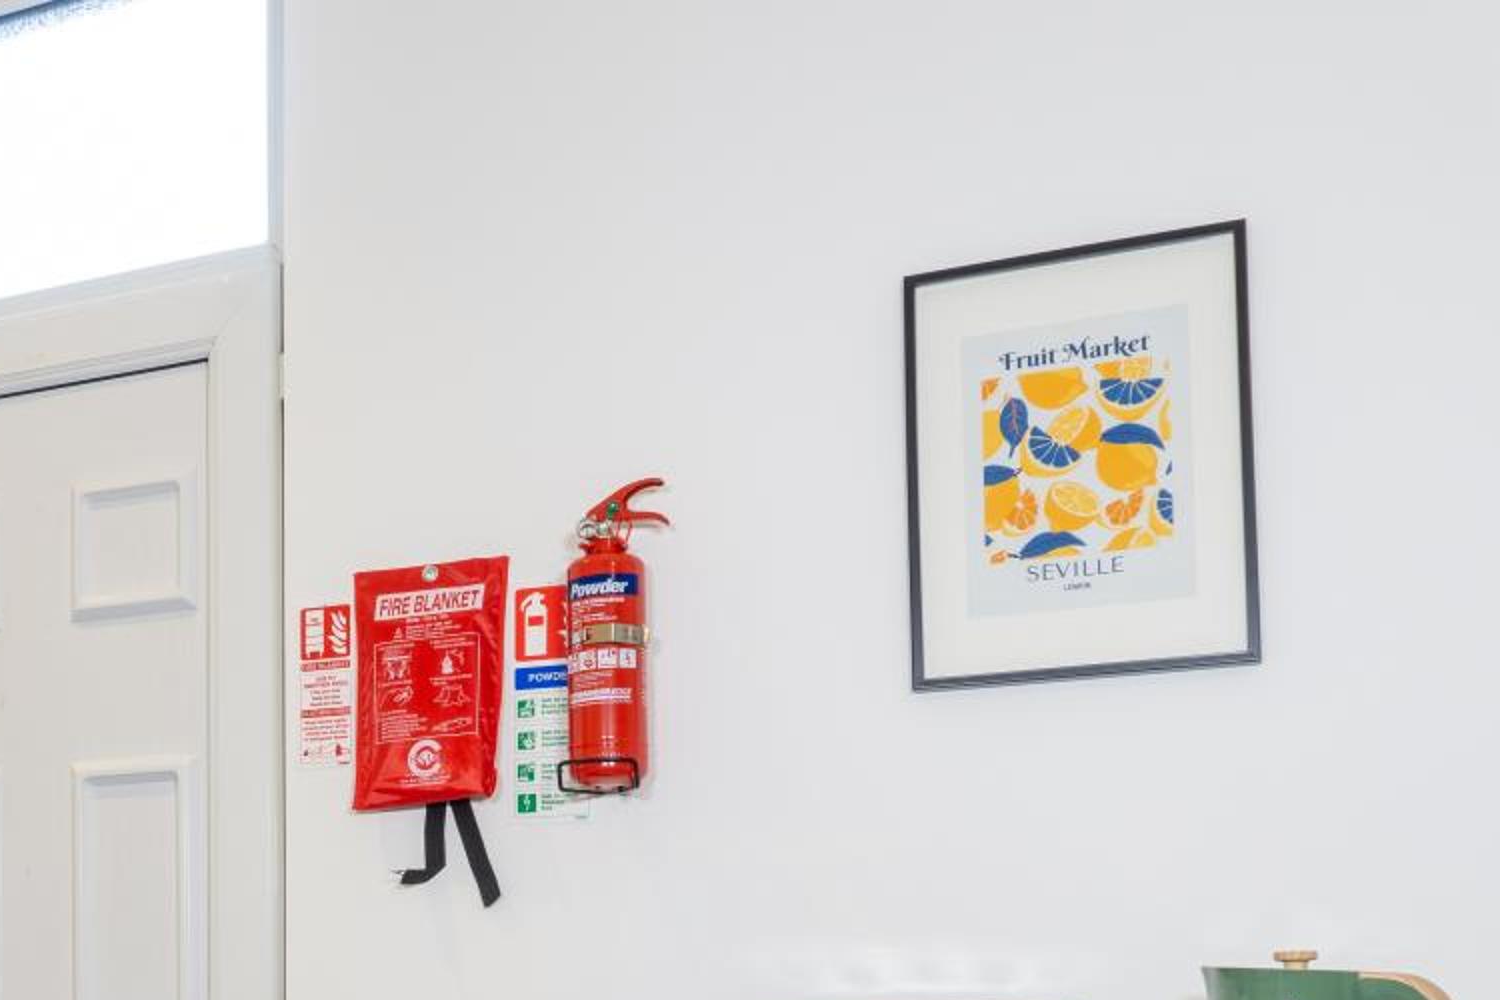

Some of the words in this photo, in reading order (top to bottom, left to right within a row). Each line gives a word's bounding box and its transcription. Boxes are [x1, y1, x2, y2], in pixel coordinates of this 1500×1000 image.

[998, 347, 1056, 371] Fruit
[1062, 335, 1150, 361] Market
[1027, 556, 1124, 581] SEVILLE
[571, 578, 629, 600] Powder
[379, 596, 411, 617] FIRE
[414, 589, 480, 613] BLANKET
[527, 671, 568, 683] POWDE
